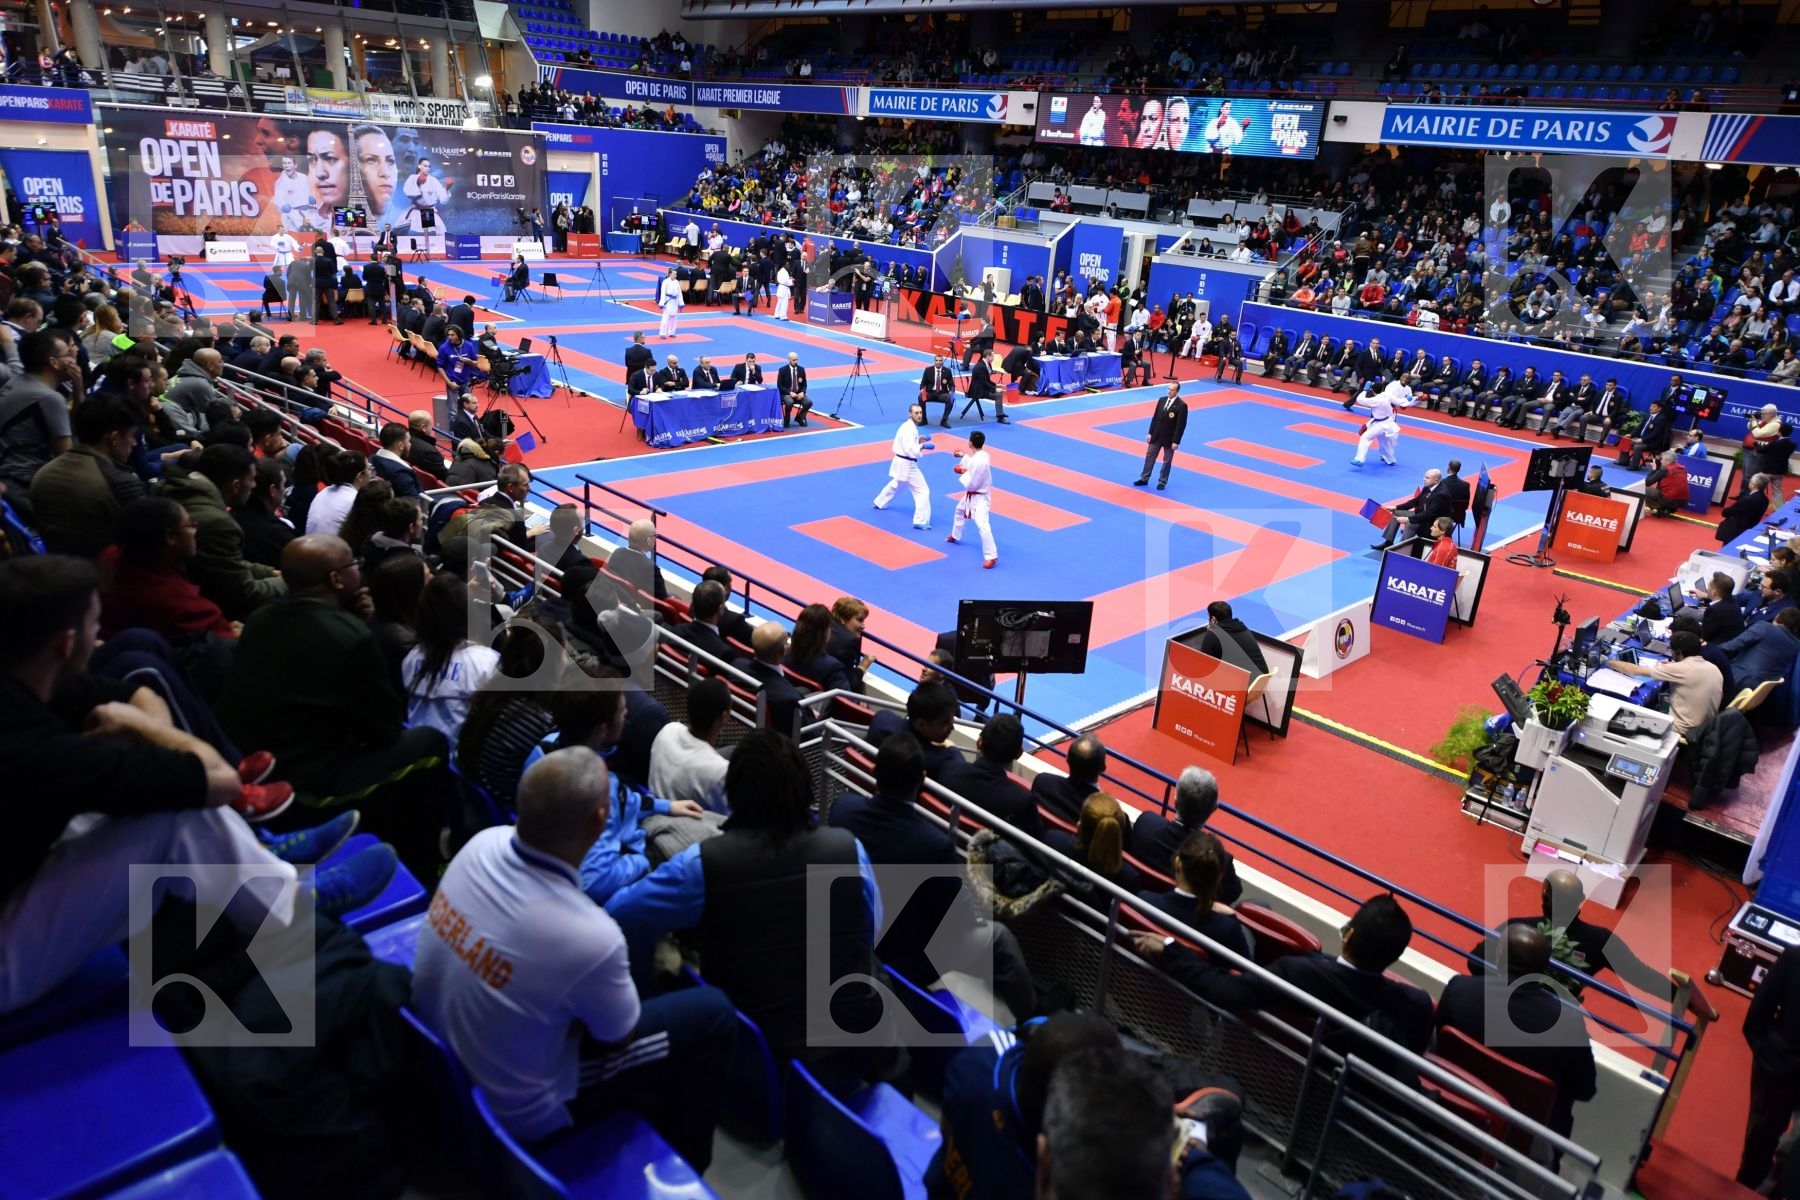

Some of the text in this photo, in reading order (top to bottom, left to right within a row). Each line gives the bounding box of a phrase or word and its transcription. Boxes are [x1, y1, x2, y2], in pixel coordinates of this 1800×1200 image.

[625, 80, 687, 100] OPEN DE PARIS
[697, 88, 781, 105] KARATE PREMIER LEAGUE
[394, 99, 426, 117] NORS
[427, 102, 470, 119] SPORTS
[873, 95, 979, 113] MAIRIE DE PARIS
[169, 121, 213, 138] KARATÉ
[1391, 114, 1612, 143] MAIRIE DE PARIS
[140, 137, 222, 177] OPEN
[704, 143, 719, 153] OPEN
[709, 152, 725, 162] PARIS
[23, 177, 65, 196] OPEN
[150, 179, 260, 217] DE PARIS
[550, 192, 573, 207] OPEN
[1080, 252, 1102, 268] OPEN
[1085, 266, 1110, 282] PARIS
[1566, 510, 1619, 530] KARATÉ
[1387, 576, 1447, 604] KARATÉ
[1171, 673, 1237, 713] KARATÉ
